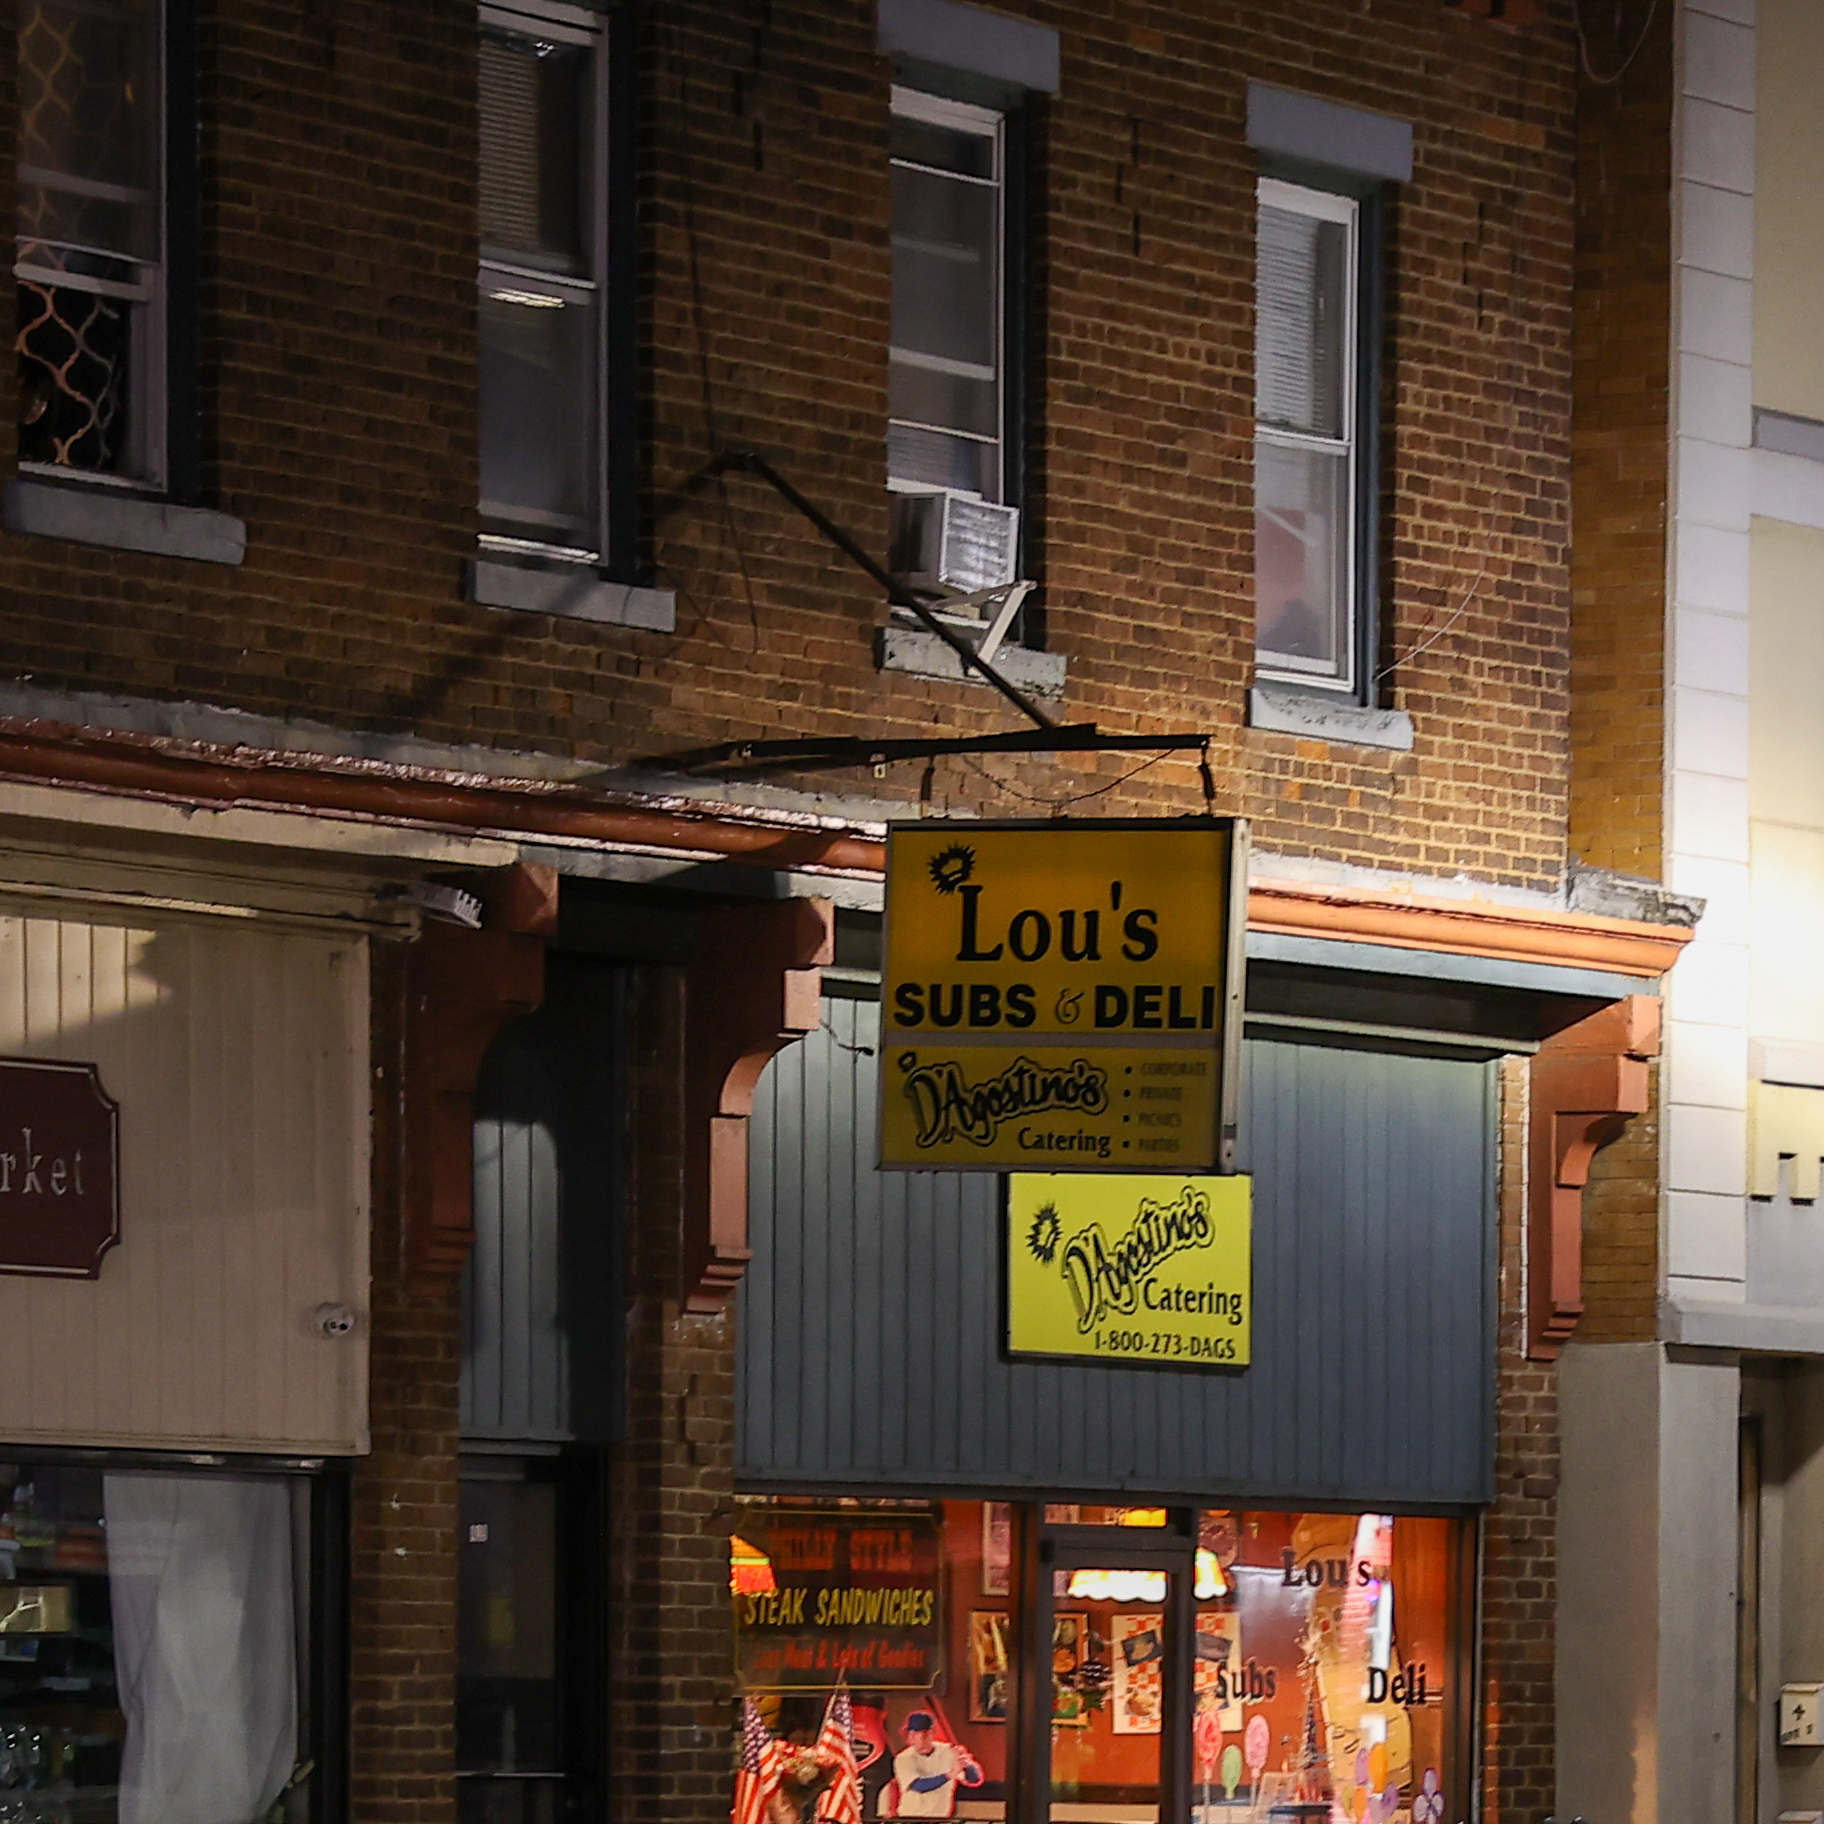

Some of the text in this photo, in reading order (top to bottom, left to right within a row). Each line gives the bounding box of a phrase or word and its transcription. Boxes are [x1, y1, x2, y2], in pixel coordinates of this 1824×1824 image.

[956, 881, 1159, 962] Lou's
[894, 983, 1216, 1030] SUBS & DELI
[1018, 1128, 1111, 1158] Catering
[1144, 1277, 1244, 1326] Catering
[1094, 1328, 1237, 1360] 1-800-273-DAGS
[743, 1586, 935, 1627] STEAK SANDWICHES
[1216, 1657, 1277, 1699] Subs
[1366, 1662, 1428, 1704] Deli
